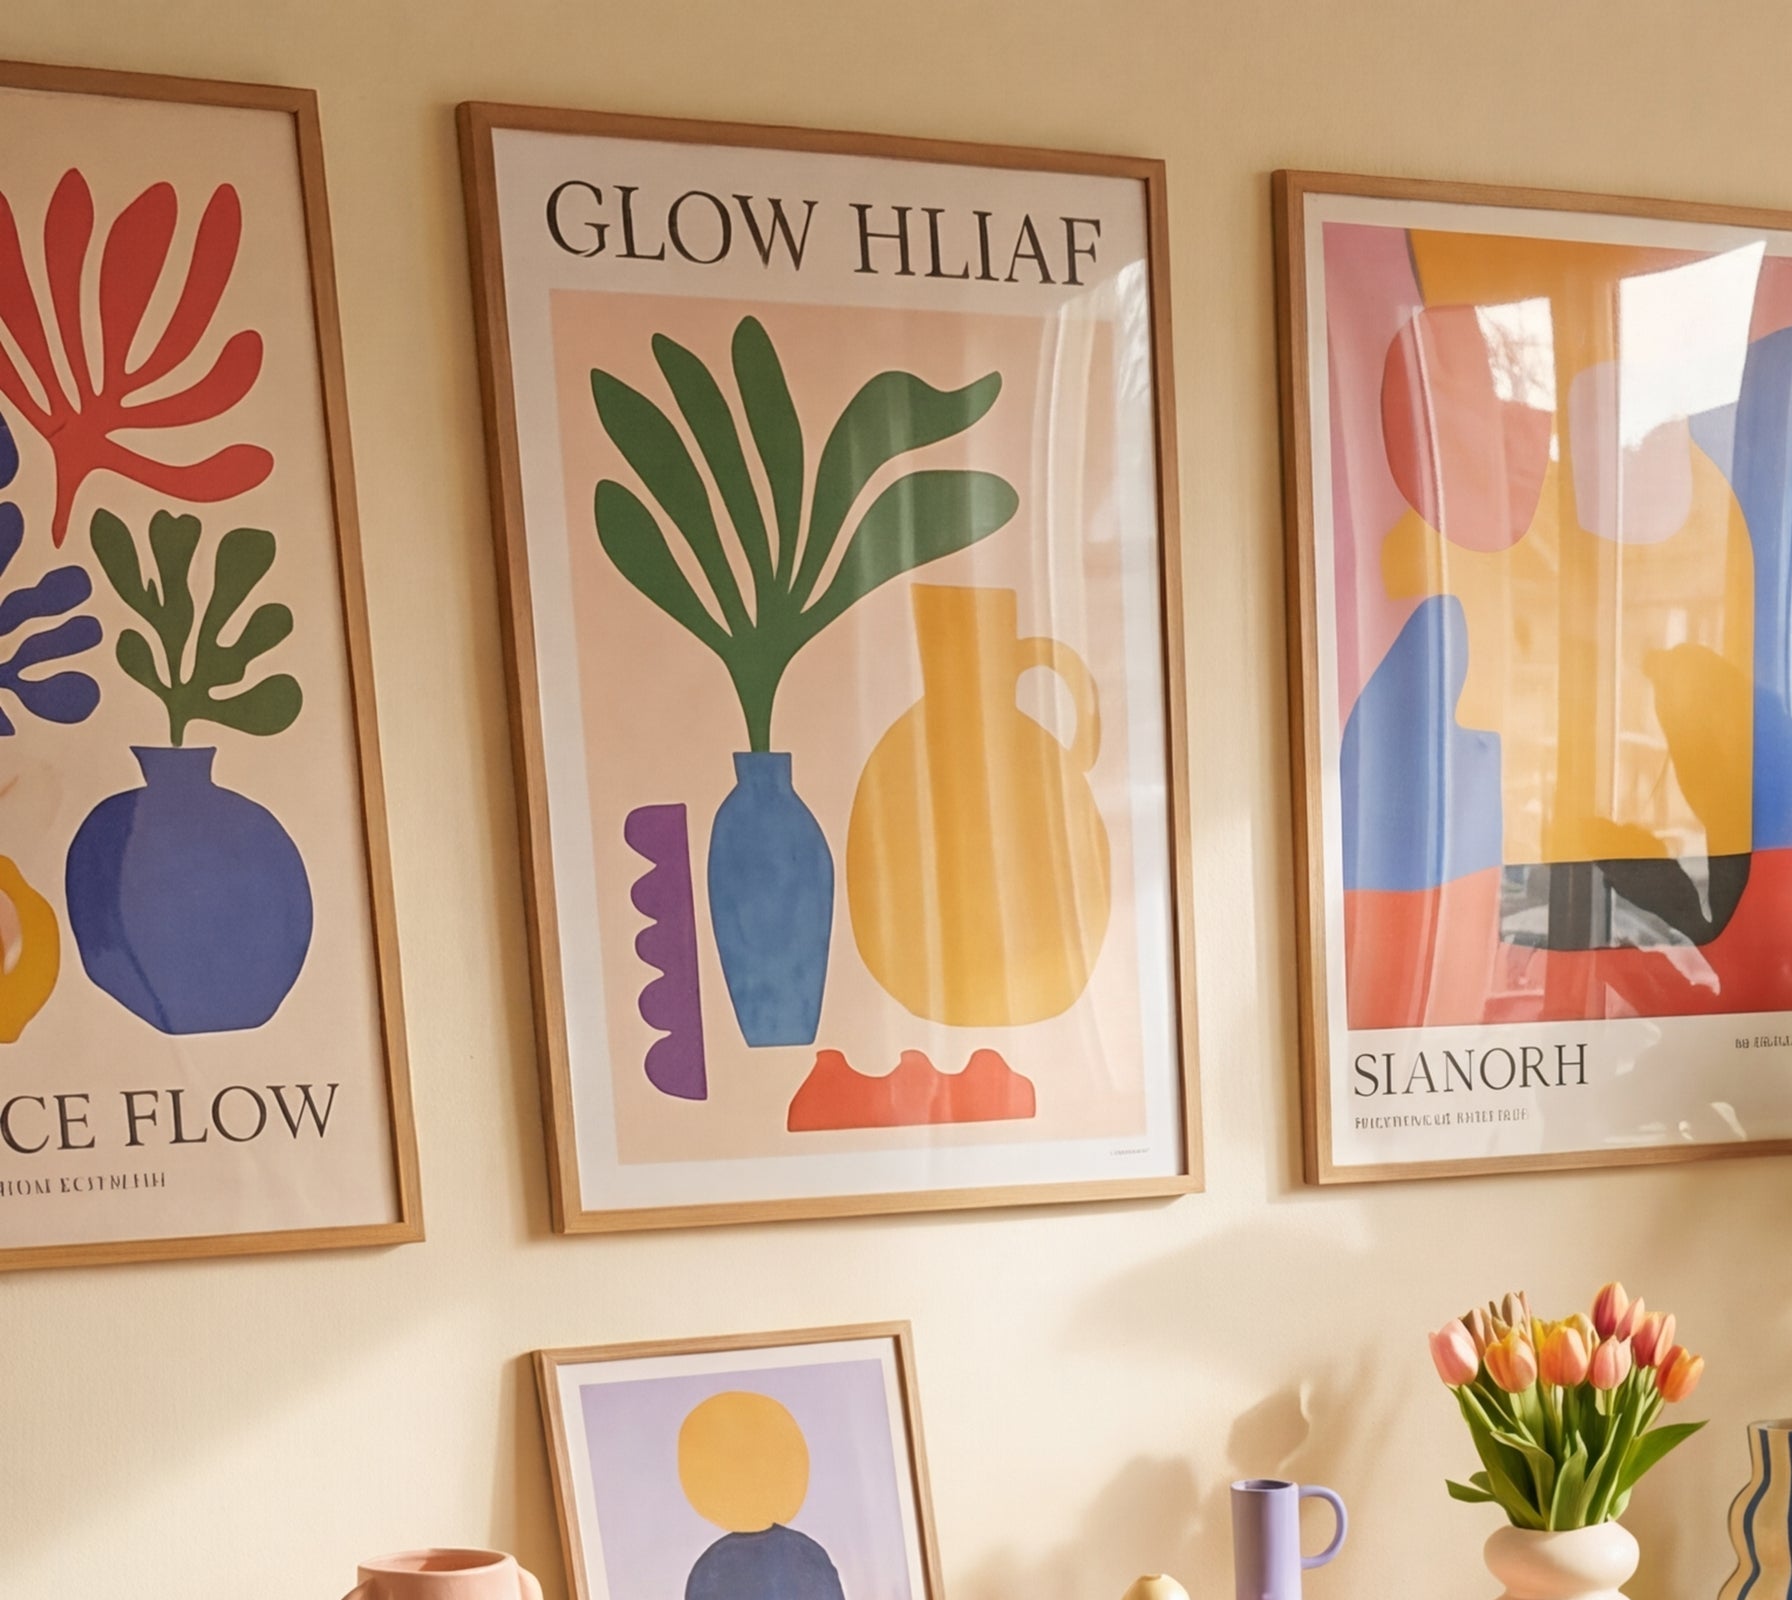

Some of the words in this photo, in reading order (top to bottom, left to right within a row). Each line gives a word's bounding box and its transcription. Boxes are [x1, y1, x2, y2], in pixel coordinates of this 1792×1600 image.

[545, 179, 818, 272] GLOW
[848, 202, 1102, 287] HLIAF
[1353, 1042, 1590, 1098] SIANORH
[0, 1092, 96, 1155] CE
[119, 1082, 340, 1147] FLOW
